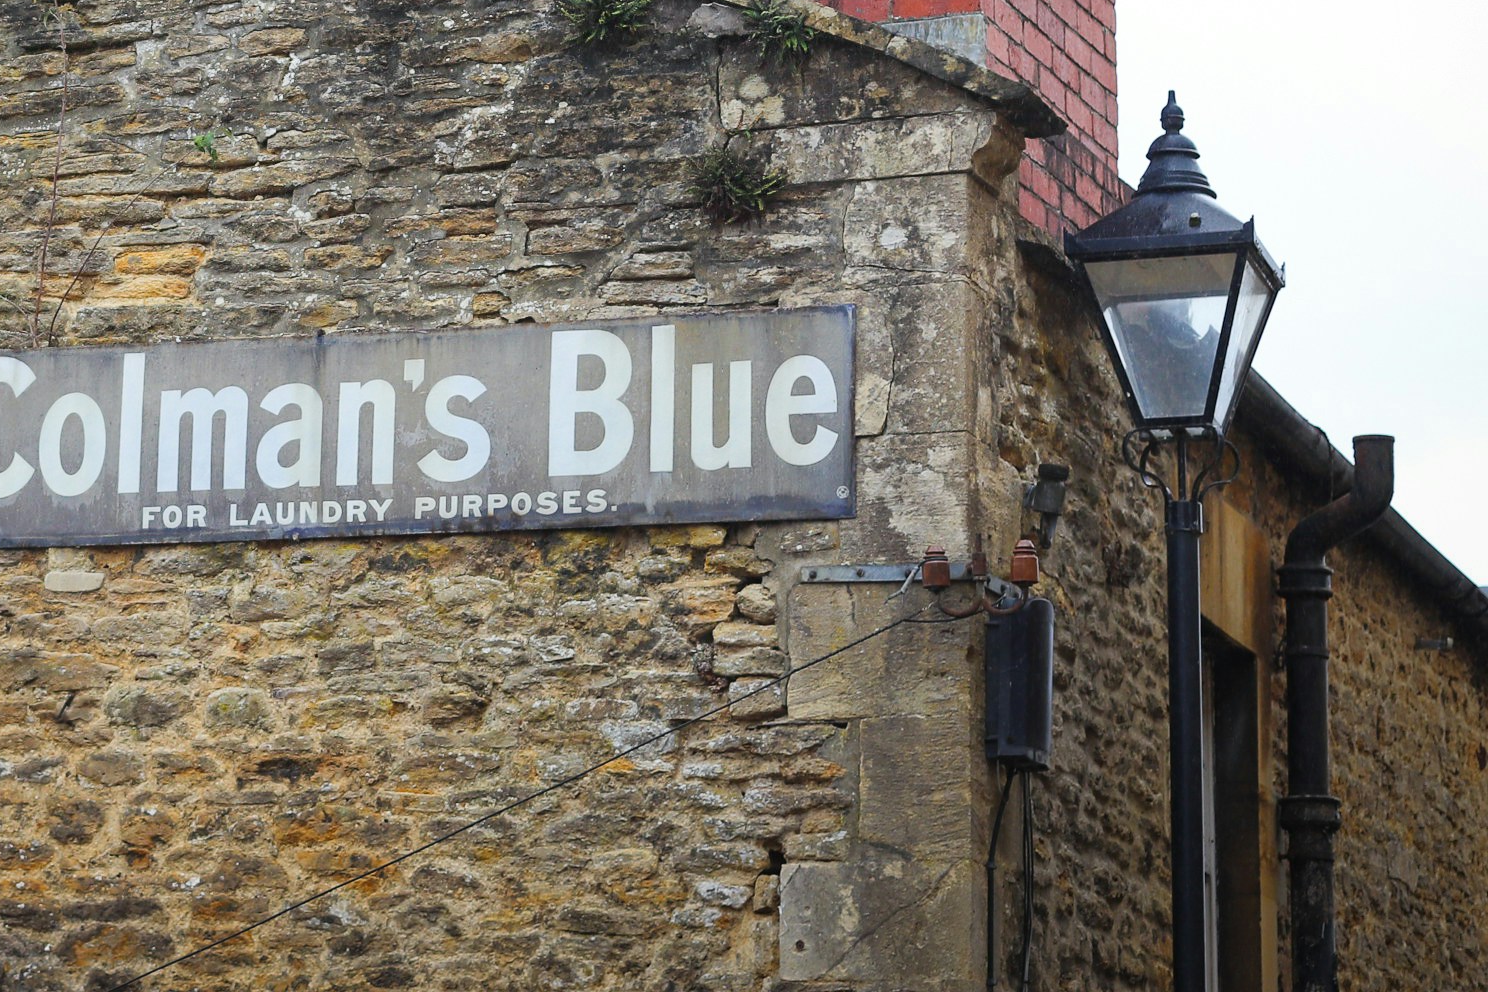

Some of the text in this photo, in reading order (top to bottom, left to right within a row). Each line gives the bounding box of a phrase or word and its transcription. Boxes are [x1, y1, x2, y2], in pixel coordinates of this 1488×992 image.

[548, 325, 839, 477] Blue
[142, 489, 618, 529] FOR LAUNDRY PURPOSES.
